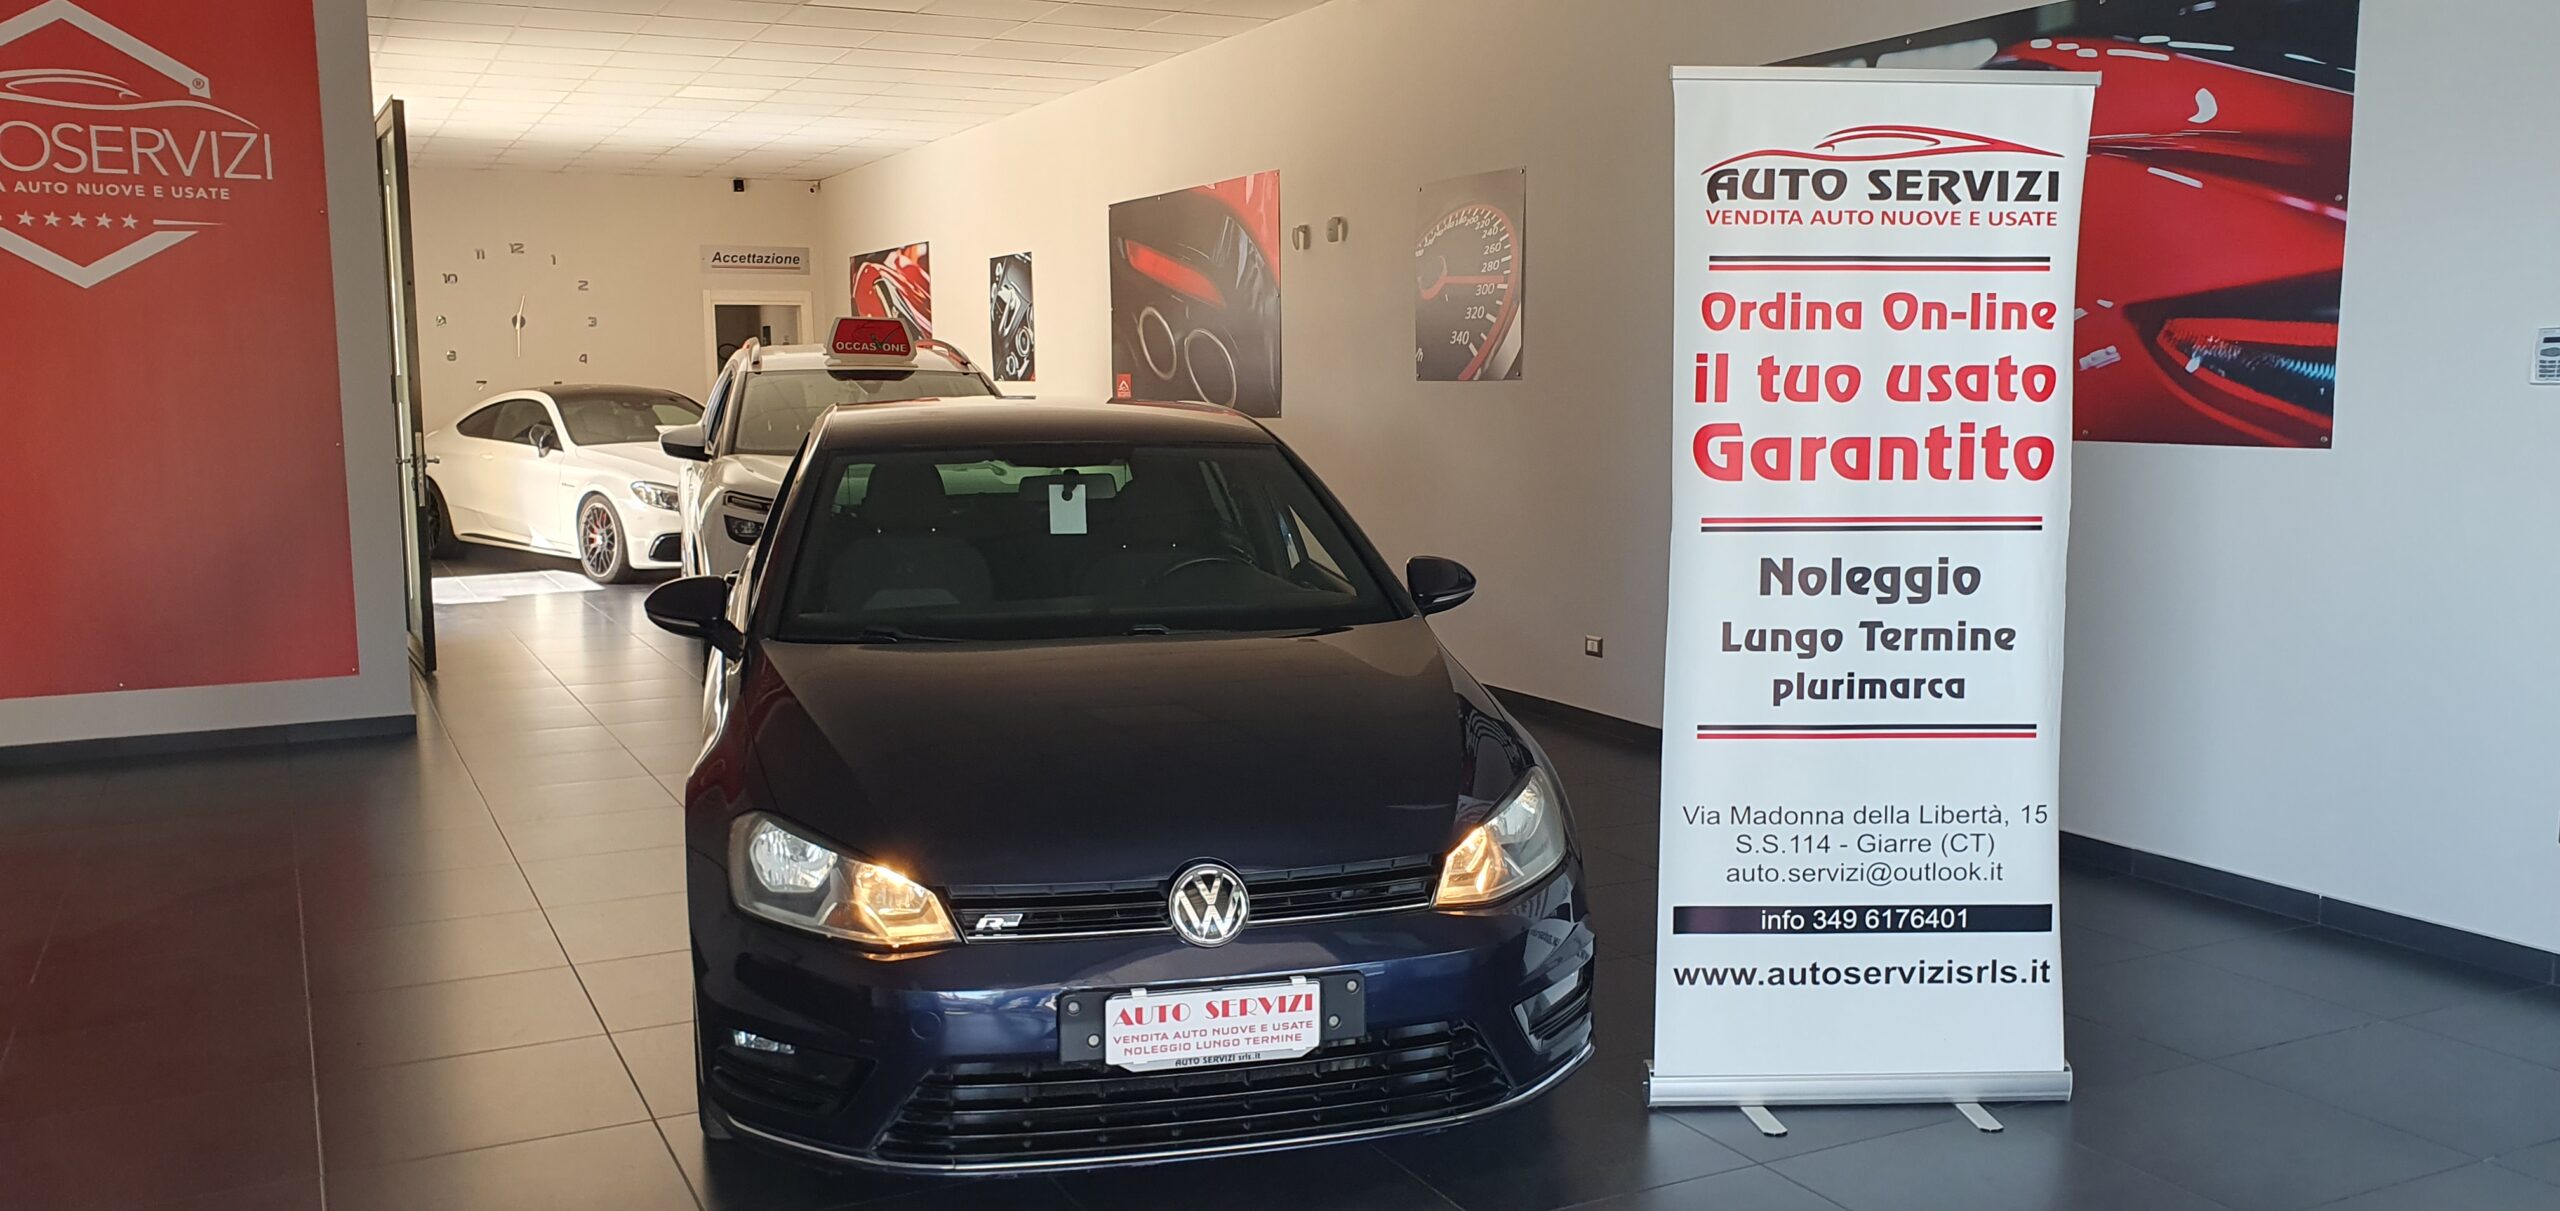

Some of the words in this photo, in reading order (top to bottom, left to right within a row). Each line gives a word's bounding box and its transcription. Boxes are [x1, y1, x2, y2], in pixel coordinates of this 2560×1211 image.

[14, 181, 68, 195] AUTO
[76, 184, 146, 197] NUOVE
[153, 185, 164, 198] E
[171, 186, 231, 200] USATE
[1706, 168, 1848, 204] AUTO
[1867, 169, 2060, 205] SERVIZI
[1705, 209, 1803, 225] VENDITA
[1809, 209, 1874, 226] AUTO
[1880, 210, 1962, 226] NUOVE
[1969, 211, 1981, 226] E
[1988, 211, 2058, 227] USATE
[1482, 226, 1499, 239] 240
[475, 249, 486, 260] 11
[509, 243, 524, 254] 12
[1483, 242, 1502, 256] 260
[712, 252, 800, 265] Accettazione
[1481, 260, 1500, 273] 280
[442, 273, 459, 285] 10
[578, 280, 589, 291] 2
[1475, 283, 1495, 296] 300
[1464, 306, 1485, 320] 320
[1701, 292, 1863, 331] Ordina
[1882, 292, 2057, 331] On-line
[588, 316, 597, 327] 3
[836, 341, 908, 352] OCCASONE
[1449, 331, 1470, 345] 340
[578, 353, 588, 364] 4
[1694, 352, 1730, 403] il
[1757, 355, 1862, 403] tuo
[1885, 355, 2057, 403] usato
[1692, 421, 2055, 483] Garantito
[1759, 556, 1982, 605] Noleggio
[1721, 621, 1844, 660] Lungo
[1858, 620, 2017, 652] Termine
[1772, 671, 1966, 707] plurimarca
[1682, 805, 1721, 825] Via
[1729, 805, 1844, 825] Madonna
[1852, 804, 1910, 824] della
[1919, 803, 2009, 826] Libertà,
[2020, 804, 2048, 824] 15
[1735, 833, 1831, 855] S.S.114
[1856, 832, 1932, 853] Giarre
[1940, 831, 1996, 858] (CT)
[1725, 861, 2004, 887] auto.servizi@outlook.it
[1760, 909, 1804, 930] info
[1812, 910, 1858, 929] 349
[1864, 908, 1969, 929] 6176401
[1673, 959, 2052, 986] www.autoservizisrls.it
[1112, 1003, 1191, 1028] AUTO
[1204, 993, 1314, 1021] SERVIZI
[1113, 1033, 1169, 1045] VENDITA
[1173, 1029, 1208, 1040] AUTO
[1212, 1025, 1256, 1036] NUOVE
[1260, 1024, 1268, 1033] E
[1272, 1020, 1314, 1032] USATE
[1124, 1042, 1192, 1056] NOLEGGIO
[1196, 1038, 1240, 1050] LUNGO
[1246, 1033, 1303, 1046] TERMINE
[1175, 1058, 1200, 1067] AUTO
[1202, 1055, 1236, 1065] SERVIZI
